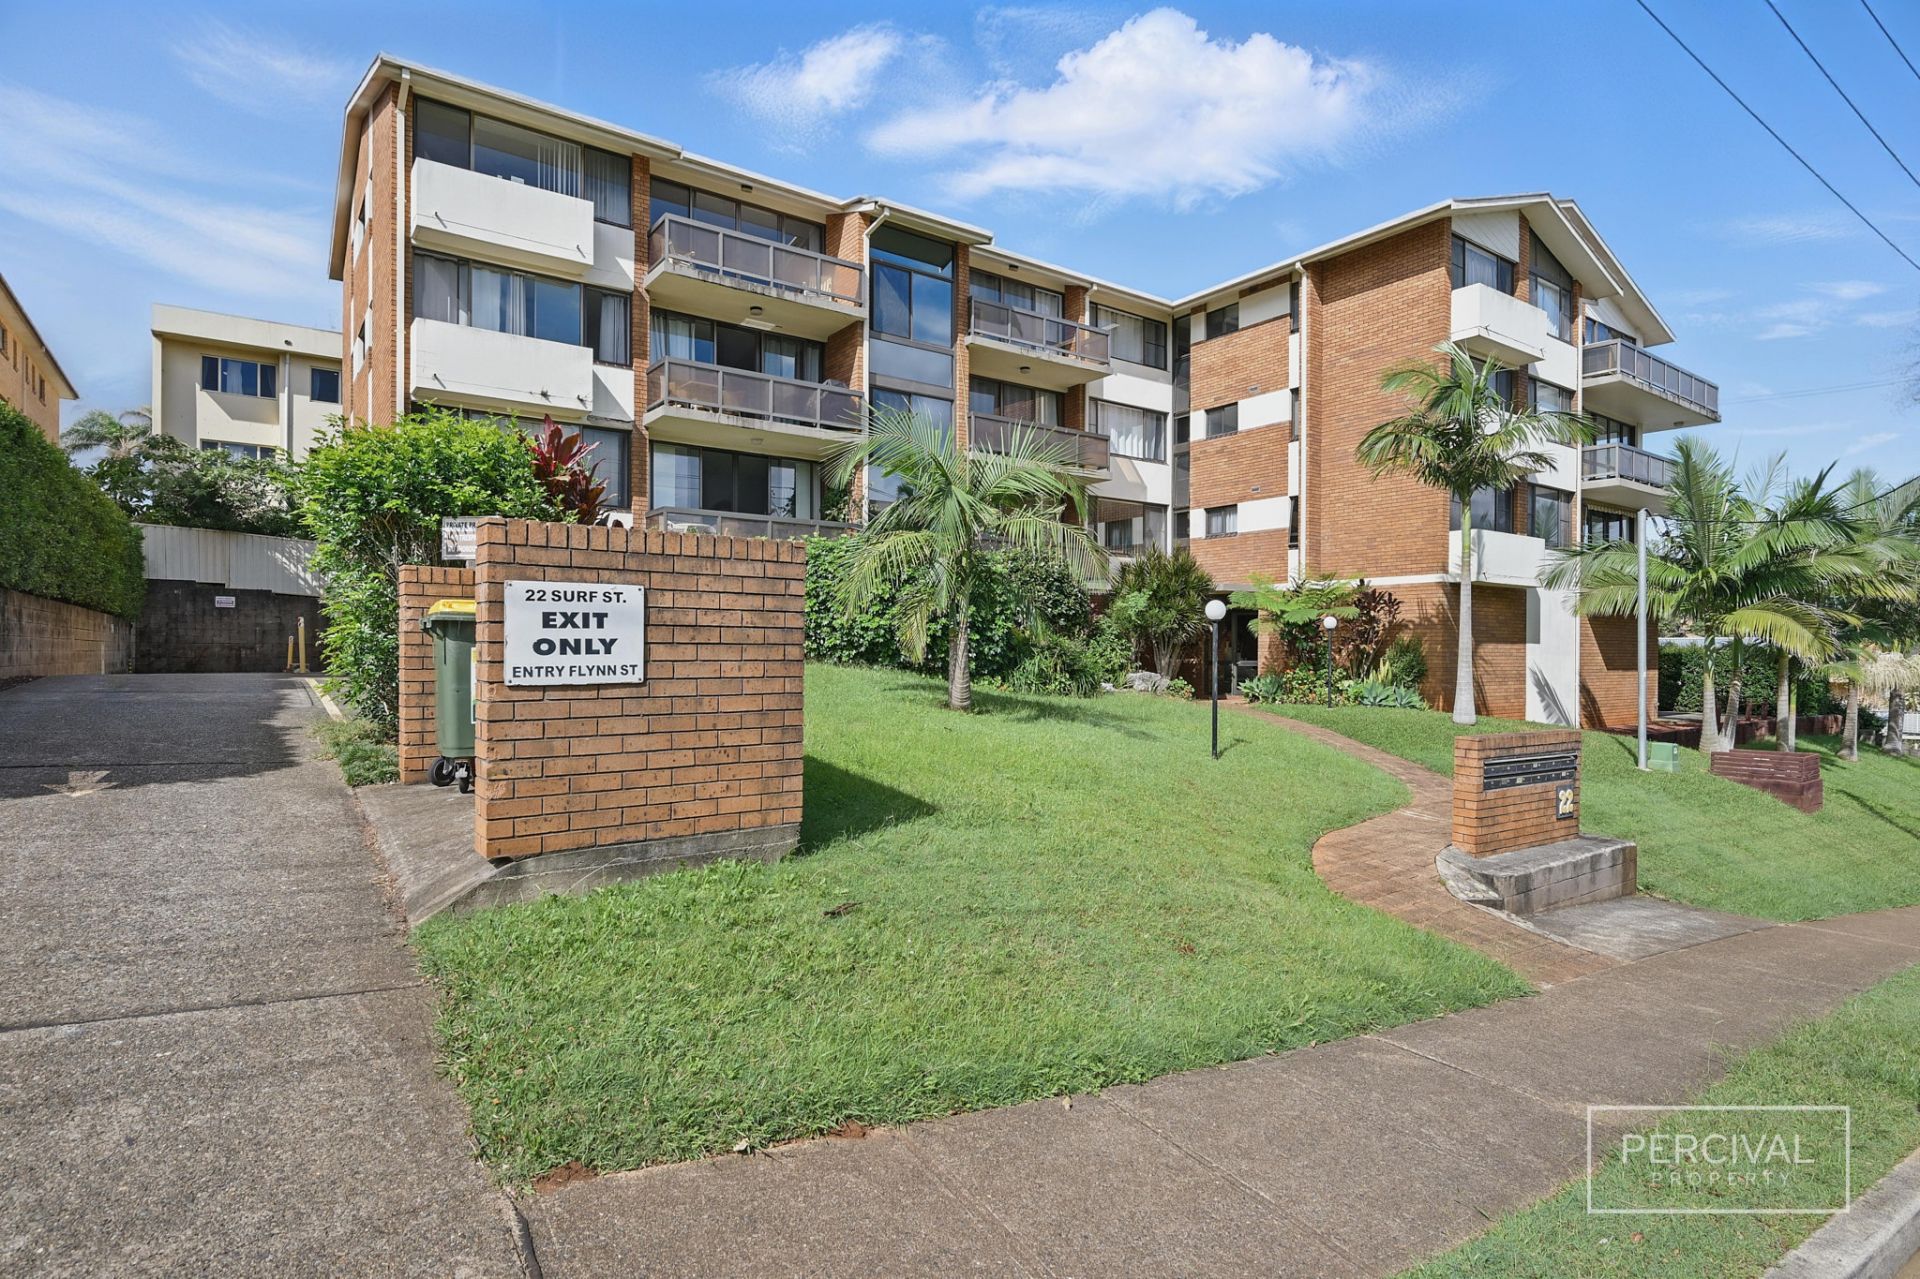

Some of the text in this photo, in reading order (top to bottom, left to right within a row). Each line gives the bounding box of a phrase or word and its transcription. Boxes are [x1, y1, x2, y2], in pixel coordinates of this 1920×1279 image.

[525, 589, 627, 603] 22 SURF ST.
[541, 611, 609, 629] EXIT
[532, 638, 618, 656] ONLY
[512, 664, 638, 678] ENTRY FLYNN ST
[1558, 789, 1574, 815] 22
